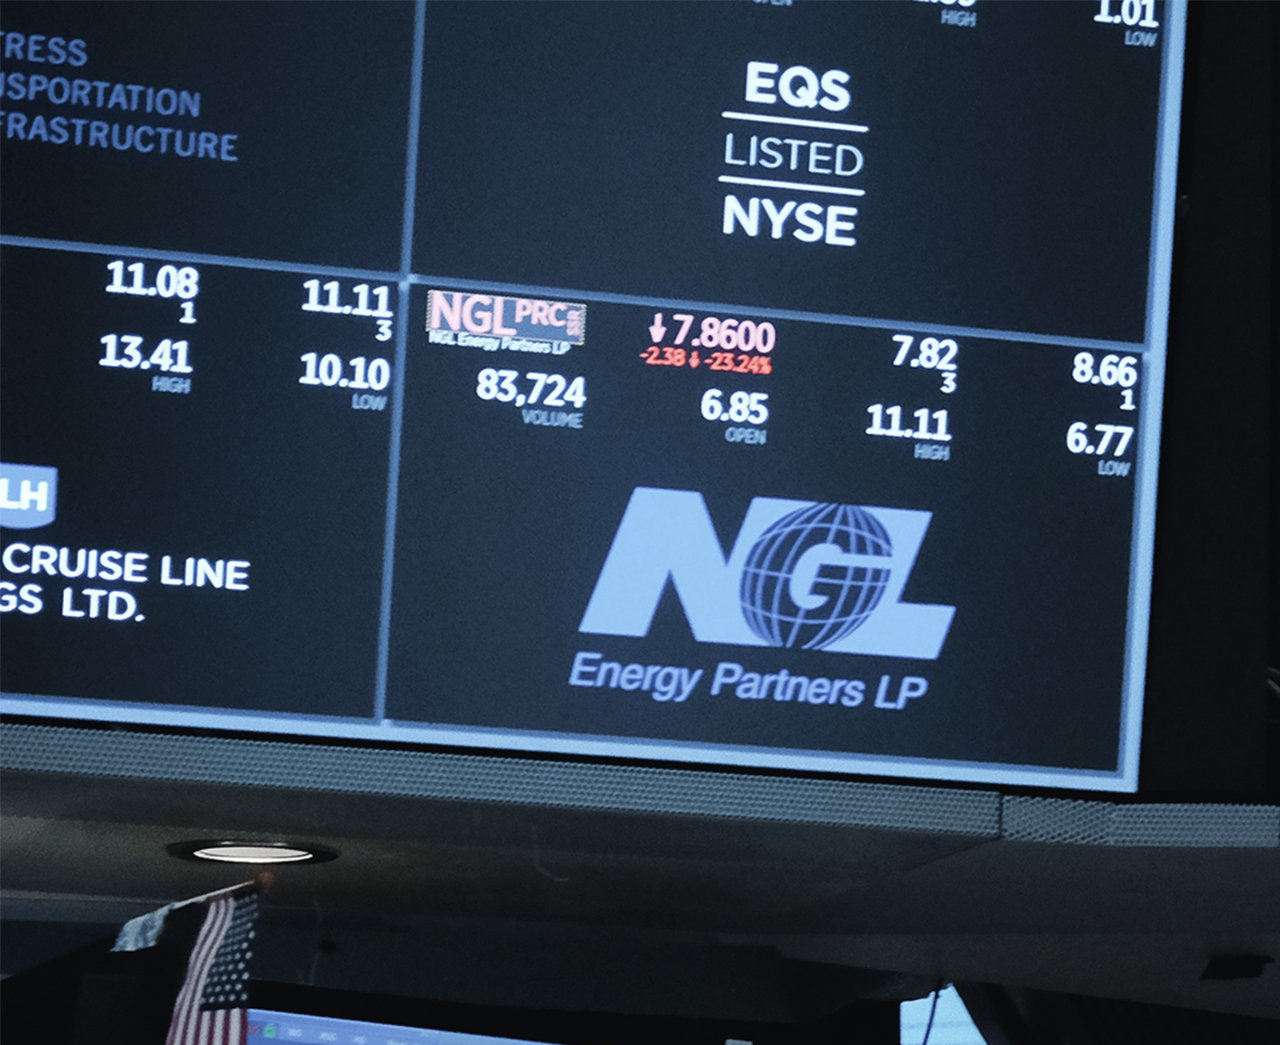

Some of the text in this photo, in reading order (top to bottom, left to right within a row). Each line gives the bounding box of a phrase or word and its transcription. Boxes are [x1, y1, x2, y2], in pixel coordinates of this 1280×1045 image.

[941, 9, 978, 28] HIGH
[0, 31, 88, 67] RESS
[1124, 29, 1158, 48] LOW
[0, 72, 201, 118] SPORTATION
[745, 61, 851, 112] EQS
[724, 133, 865, 177] LISTED
[722, 194, 859, 247] NYSE
[106, 260, 199, 299] 11.08
[179, 302, 196, 324] 1
[301, 279, 394, 319] 11.11
[430, 290, 518, 336] NGL
[374, 320, 392, 341] 3
[673, 313, 776, 353] 7.8600
[98, 334, 193, 374] 13.41
[891, 334, 959, 371] 7.82
[1072, 352, 1138, 387] 8.66
[153, 376, 191, 394] HIGH
[298, 352, 391, 391] 10.10
[475, 367, 588, 408] 83,724
[940, 373, 958, 393] 3
[352, 395, 388, 411] LOW
[521, 409, 584, 429] VOLUME
[700, 388, 769, 425] 6.85
[1119, 391, 1136, 411] 1
[724, 426, 768, 445] OPEN
[865, 404, 952, 442] 11.11
[1066, 423, 1135, 458] 6.77
[914, 443, 951, 462] HIGH
[1098, 460, 1131, 477] LOW
[2, 542, 251, 591] CRUISE LINE
[62, 586, 146, 622] LTD.
[569, 652, 929, 710] Energy Partners LP
